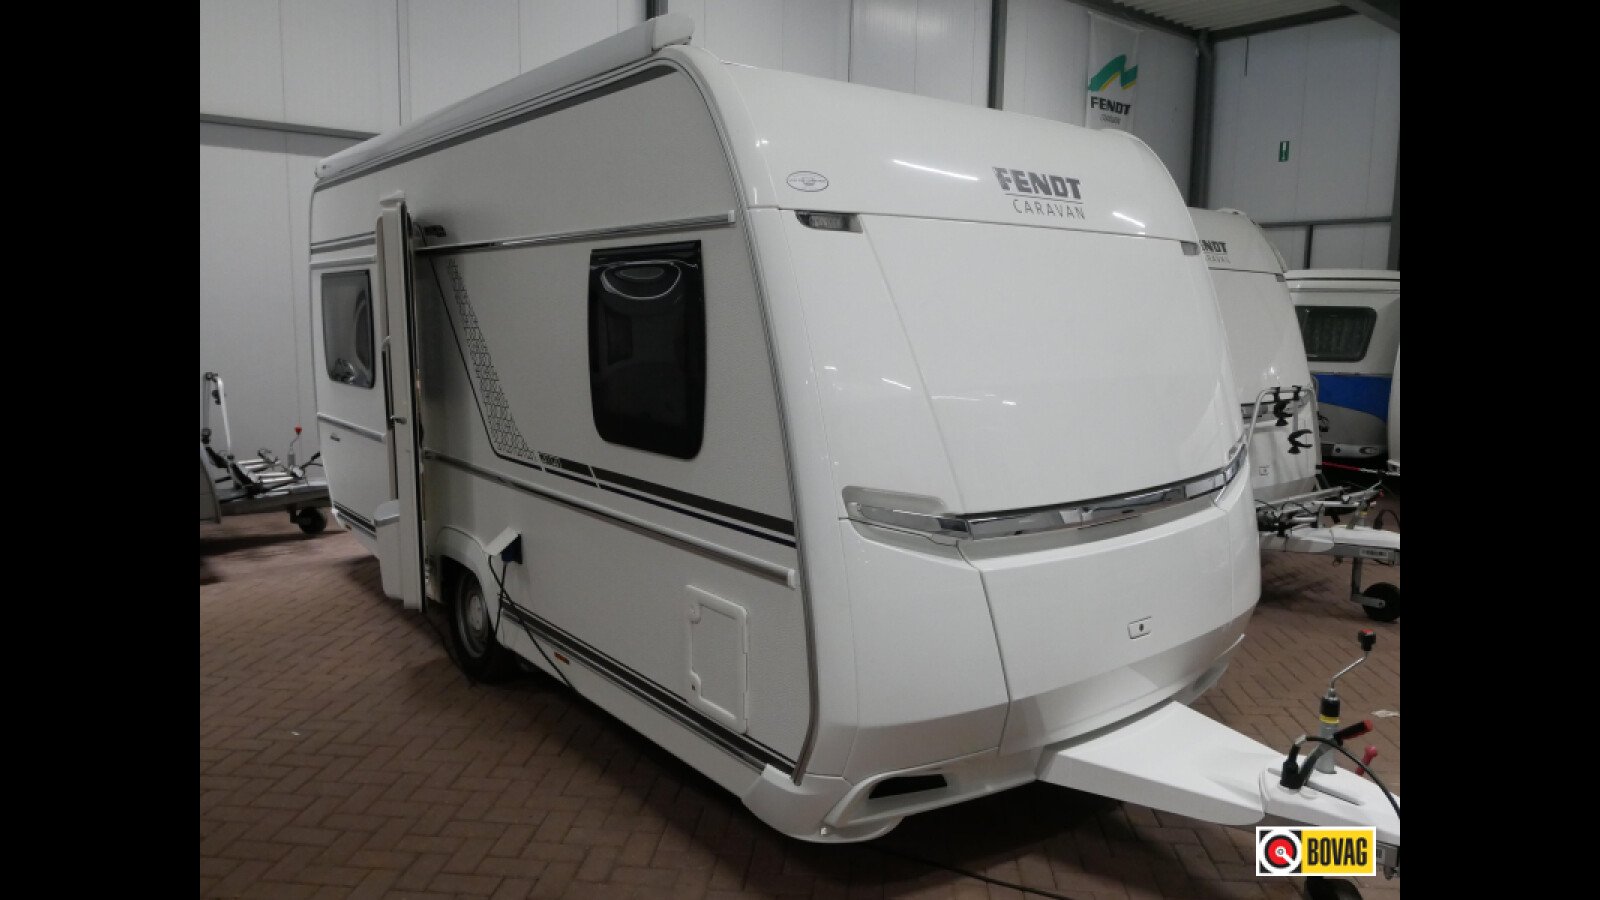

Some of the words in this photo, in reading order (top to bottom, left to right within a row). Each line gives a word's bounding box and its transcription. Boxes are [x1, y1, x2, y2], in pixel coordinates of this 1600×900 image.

[1091, 96, 1131, 115] FENDT
[993, 167, 1082, 199] FENDT
[1012, 199, 1086, 220] CARAVAN
